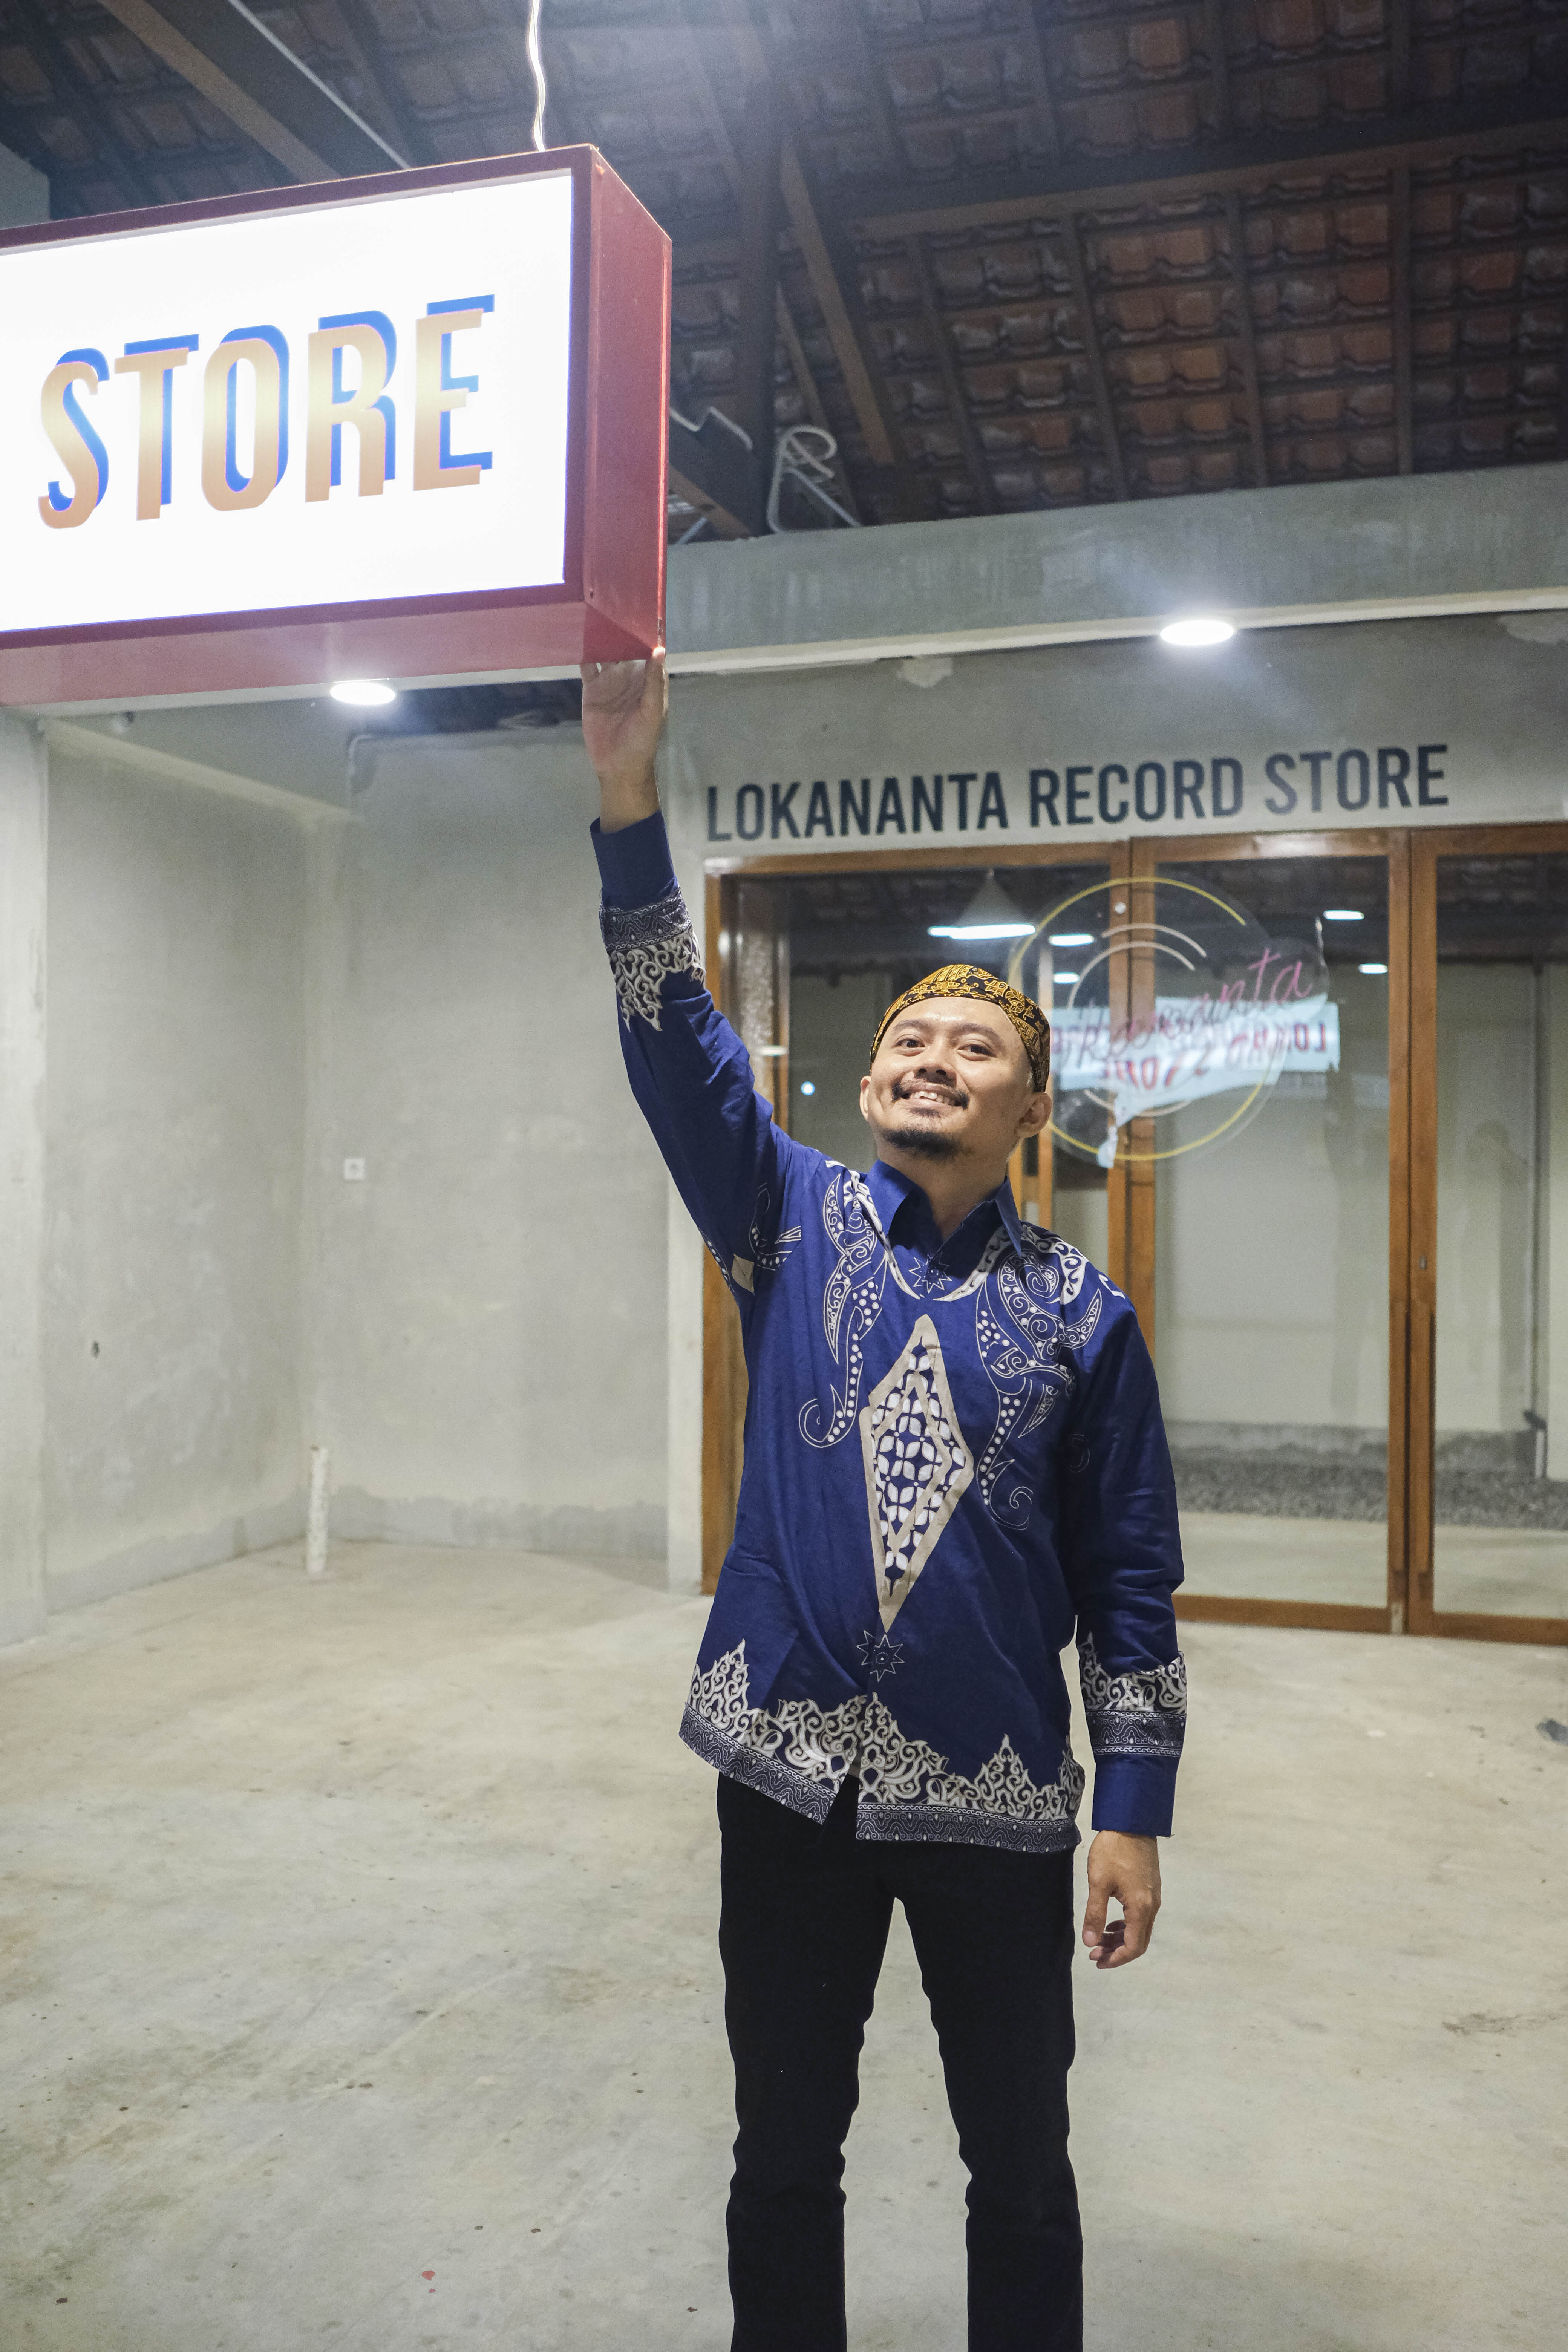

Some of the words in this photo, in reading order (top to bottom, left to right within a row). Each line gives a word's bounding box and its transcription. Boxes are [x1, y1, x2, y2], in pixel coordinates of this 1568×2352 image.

[38, 294, 495, 529] STORE
[706, 771, 1009, 841] LOKANANTA
[1028, 758, 1243, 828] RECORD
[1265, 742, 1450, 816] STORE
